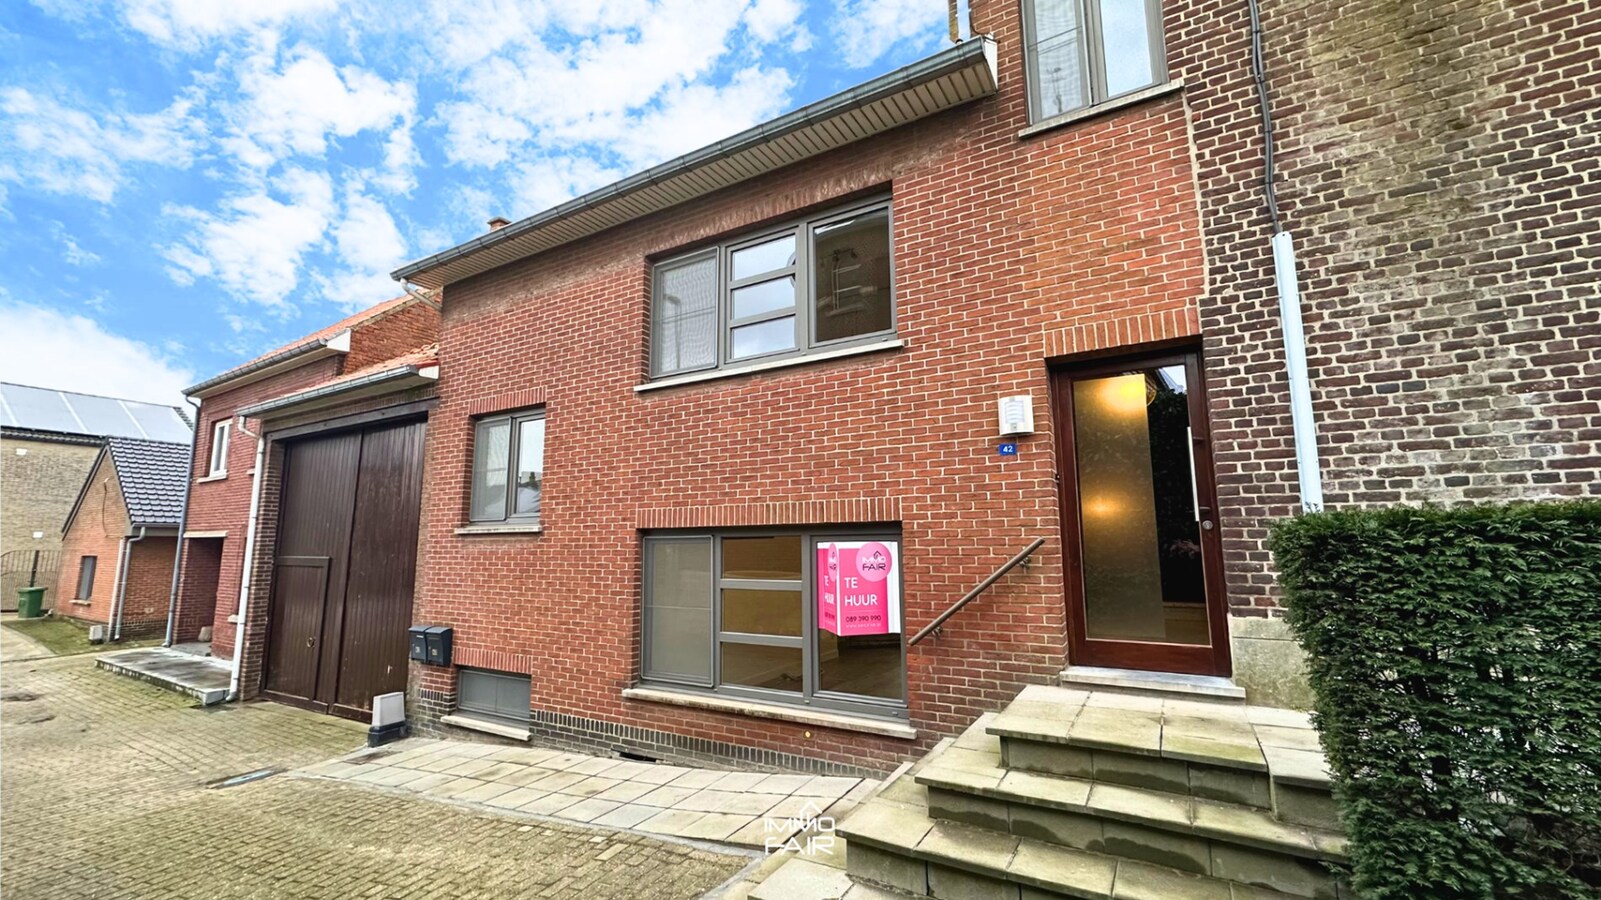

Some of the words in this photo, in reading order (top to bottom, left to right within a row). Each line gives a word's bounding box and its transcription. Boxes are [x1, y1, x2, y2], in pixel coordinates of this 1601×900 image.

[1002, 445, 1014, 453] 42
[862, 563, 887, 571] FAIR
[844, 577, 858, 589] TE
[844, 594, 878, 606] HUUR
